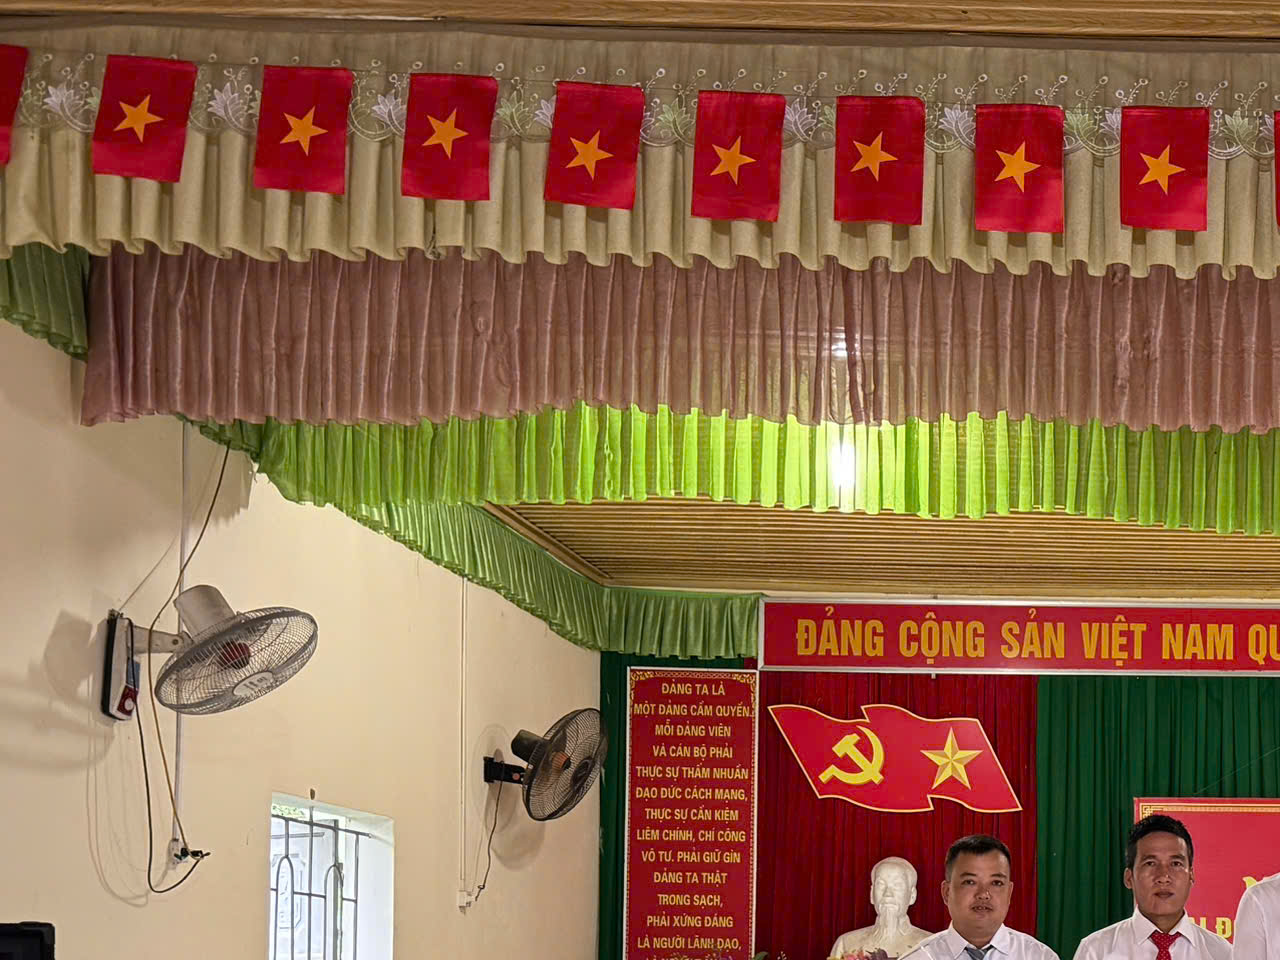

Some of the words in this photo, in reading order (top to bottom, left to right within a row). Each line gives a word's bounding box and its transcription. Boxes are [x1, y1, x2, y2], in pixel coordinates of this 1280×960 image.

[797, 606, 884, 657] ĐẢNG
[899, 612, 985, 665] CỘNG
[1000, 608, 1065, 660] SẢN
[1081, 615, 1147, 666] VIỆT
[1162, 624, 1234, 661] NAM
[661, 678, 692, 695] ĐẢNG
[695, 683, 709, 696] TA
[712, 681, 725, 696] LÀ
[633, 700, 656, 718] MỘT
[658, 699, 688, 716] ĐẢNG
[676, 720, 706, 737] ĐẢNG
[708, 722, 731, 737] VIÊN
[652, 742, 667, 757] VÀ
[669, 742, 691, 757] CÁN
[693, 743, 707, 761] BỘ
[710, 742, 733, 758] PHẢI
[635, 765, 663, 781] THỰC
[665, 765, 680, 782] SỰ
[635, 787, 658, 802] ĐẠO
[660, 784, 682, 799] ĐỨC
[684, 785, 712, 799] CÁCH
[645, 808, 672, 823] THỰC
[674, 808, 689, 824] SỰ
[714, 807, 739, 824] KIỆM
[636, 826, 659, 840] LIÊM
[698, 827, 715, 841] CHÍ
[717, 827, 746, 842] CÔNG
[641, 848, 656, 862] VÔ
[677, 846, 701, 862] PHẢI
[702, 848, 721, 863] GIỮ
[653, 867, 683, 883] ĐẢNG
[685, 872, 699, 884] TA
[701, 870, 728, 887] THẬT
[657, 893, 691, 906] TRONG
[647, 911, 670, 927] PHẢI
[673, 913, 702, 927] XỨNG
[704, 913, 734, 928] ĐÁNG
[637, 934, 650, 949] LÀ
[653, 934, 685, 949] NGƯỜI
